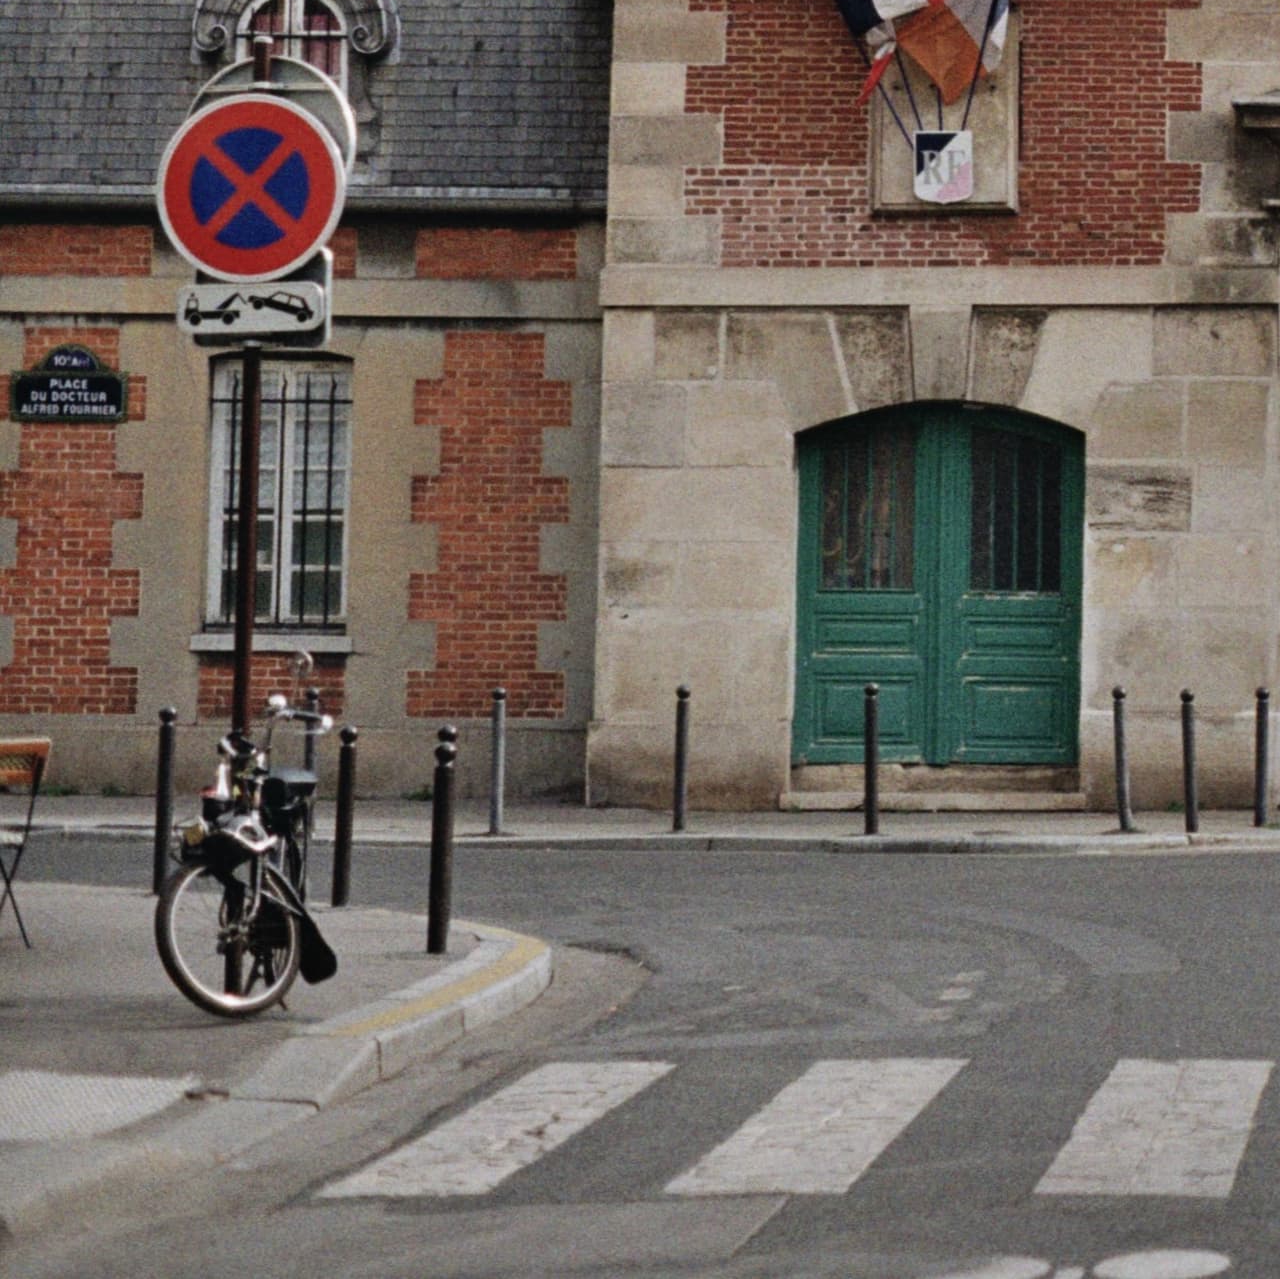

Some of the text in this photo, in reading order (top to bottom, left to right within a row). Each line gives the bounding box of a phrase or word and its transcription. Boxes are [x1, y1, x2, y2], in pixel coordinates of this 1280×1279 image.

[922, 150, 965, 185] RF
[49, 379, 88, 390] PLACE
[30, 391, 107, 402] DU DOCTEUR
[21, 404, 116, 415] ALFRED FOURNIER
